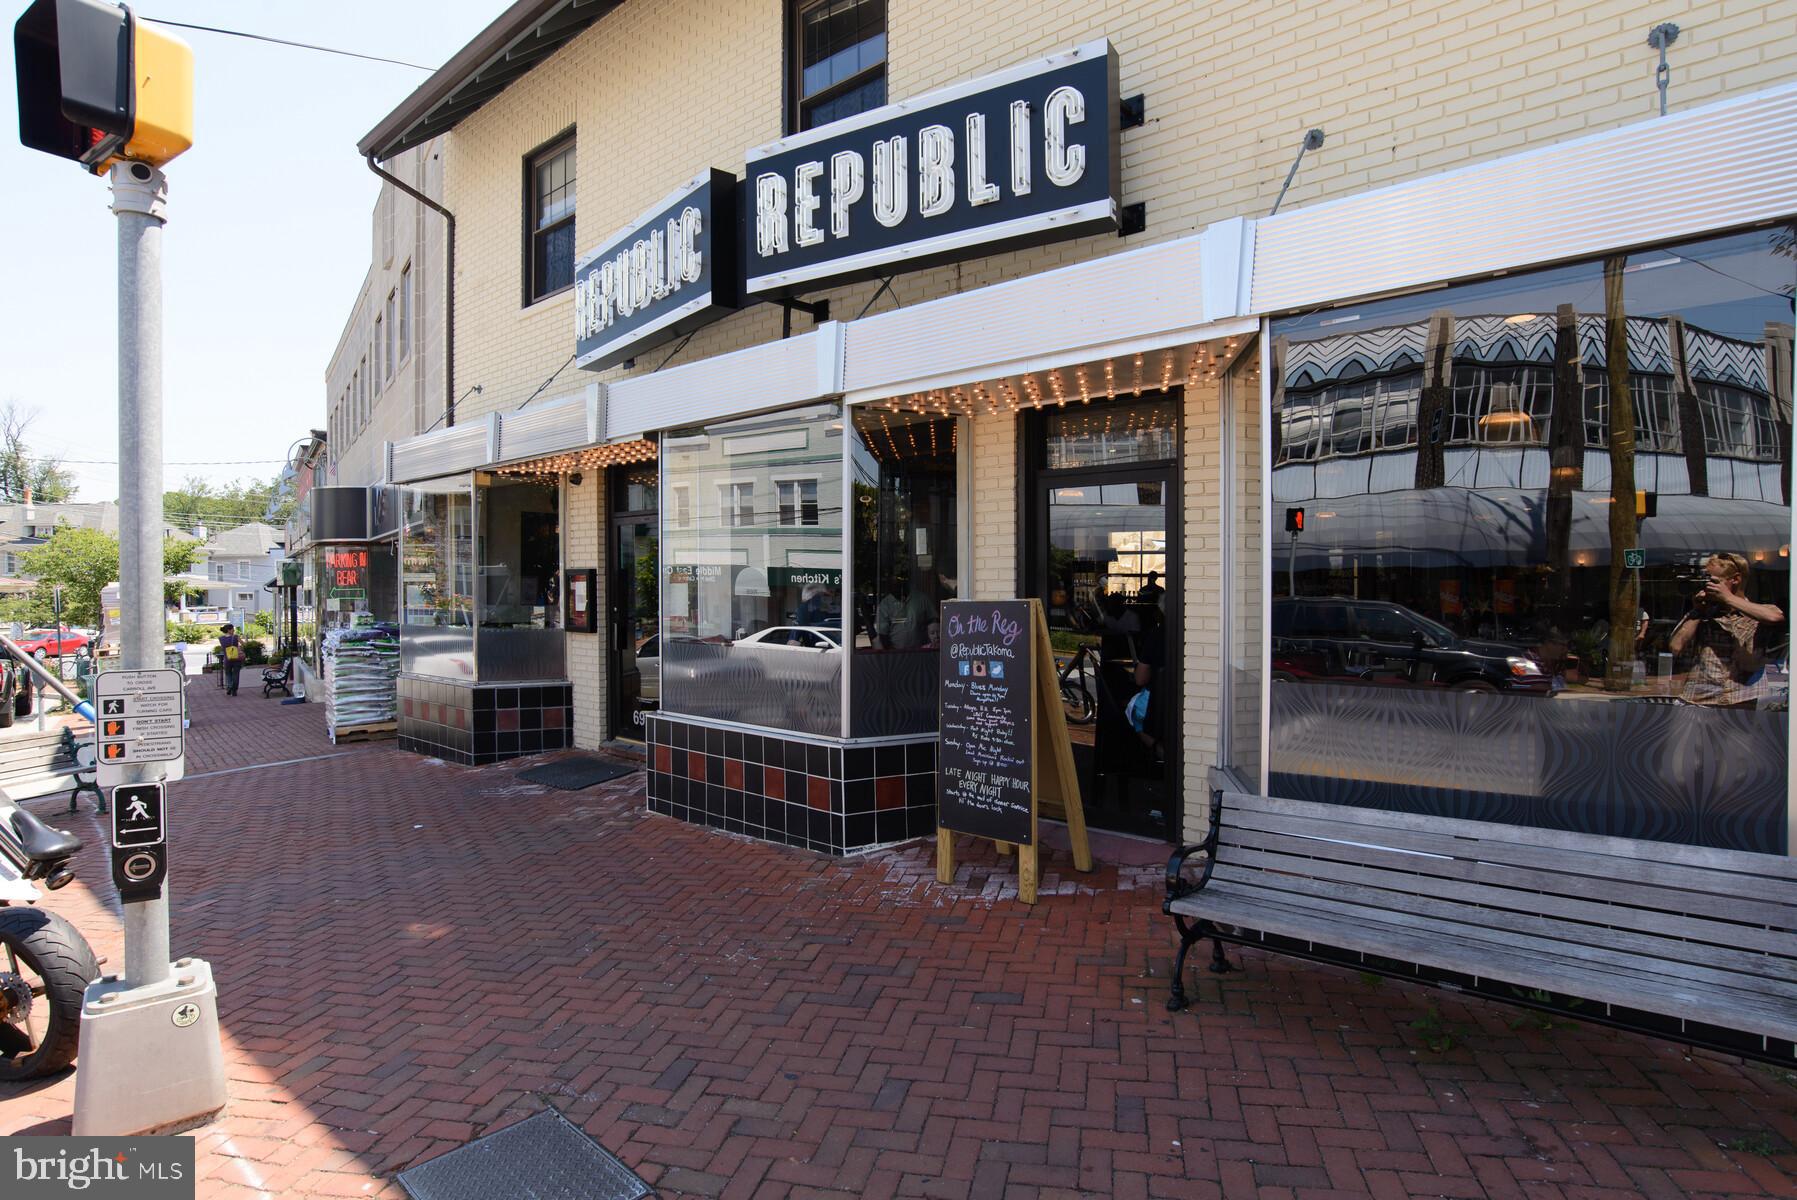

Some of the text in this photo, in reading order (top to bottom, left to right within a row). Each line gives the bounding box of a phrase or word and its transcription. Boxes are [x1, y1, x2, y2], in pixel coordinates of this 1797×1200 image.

[757, 85, 1085, 257] REPUBLIC
[576, 206, 702, 341] REPUBLIC
[948, 610, 1023, 646] On the Reg
[944, 680, 966, 694] Monday
[944, 738, 961, 750] Sunday
[945, 767, 1031, 793] LATE NIGHT HAPPY HOUR
[958, 779, 1003, 798] EVERY NIGHT
